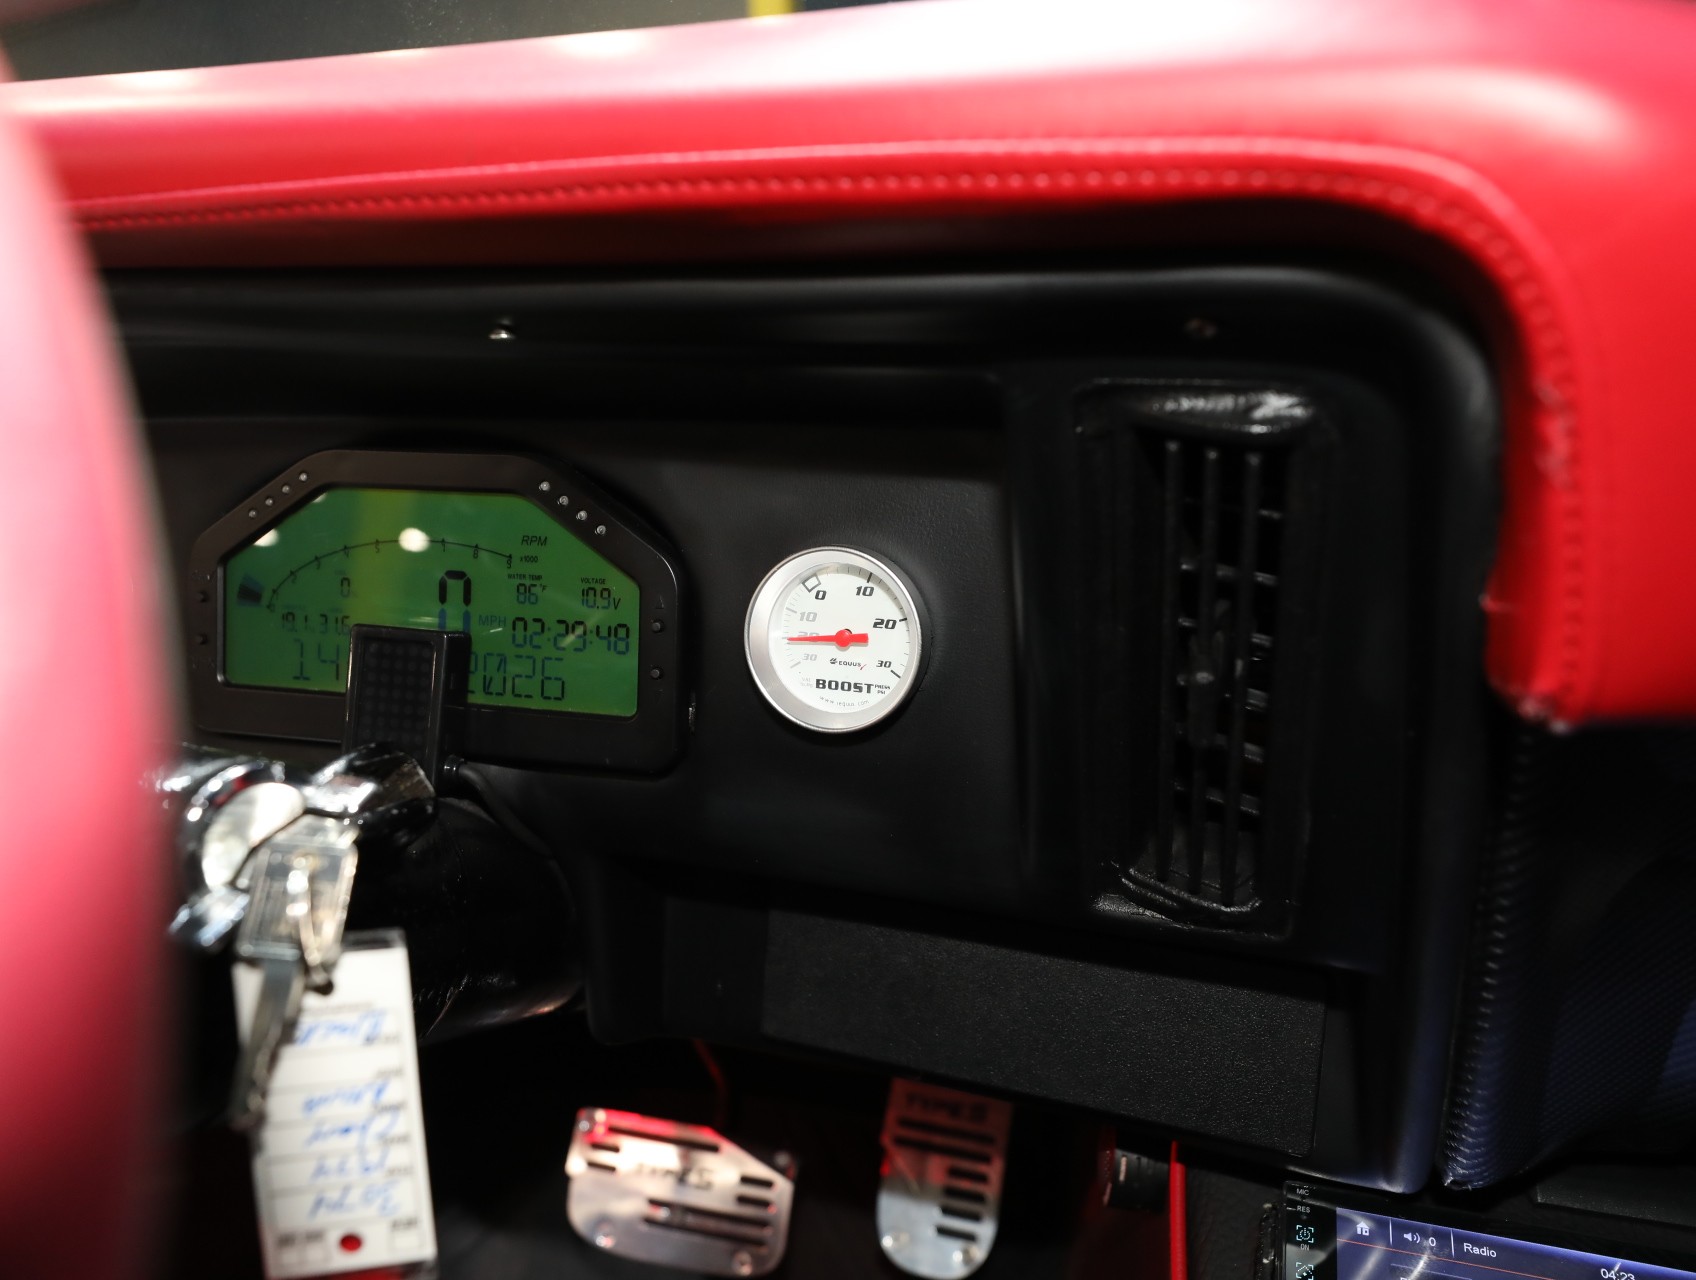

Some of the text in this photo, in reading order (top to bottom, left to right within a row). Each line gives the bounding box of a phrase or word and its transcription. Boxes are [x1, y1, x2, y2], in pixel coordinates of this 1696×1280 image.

[521, 535, 548, 546] RPM
[581, 577, 606, 585] VOLTAGE
[340, 577, 351, 598] 0
[855, 586, 875, 597] 10
[814, 589, 827, 601] 0
[478, 615, 506, 627] MPH
[799, 611, 818, 623] 10
[872, 618, 897, 630] 20
[802, 653, 818, 662] 30
[876, 660, 892, 669] 30
[815, 678, 875, 694] BOOST
[1296, 1188, 1310, 1196] MIC
[1296, 1205, 1311, 1214] RES
[1428, 1236, 1437, 1247] 0
[1463, 1242, 1497, 1258] Radio
[1600, 1268, 1635, 1280] 04:23
